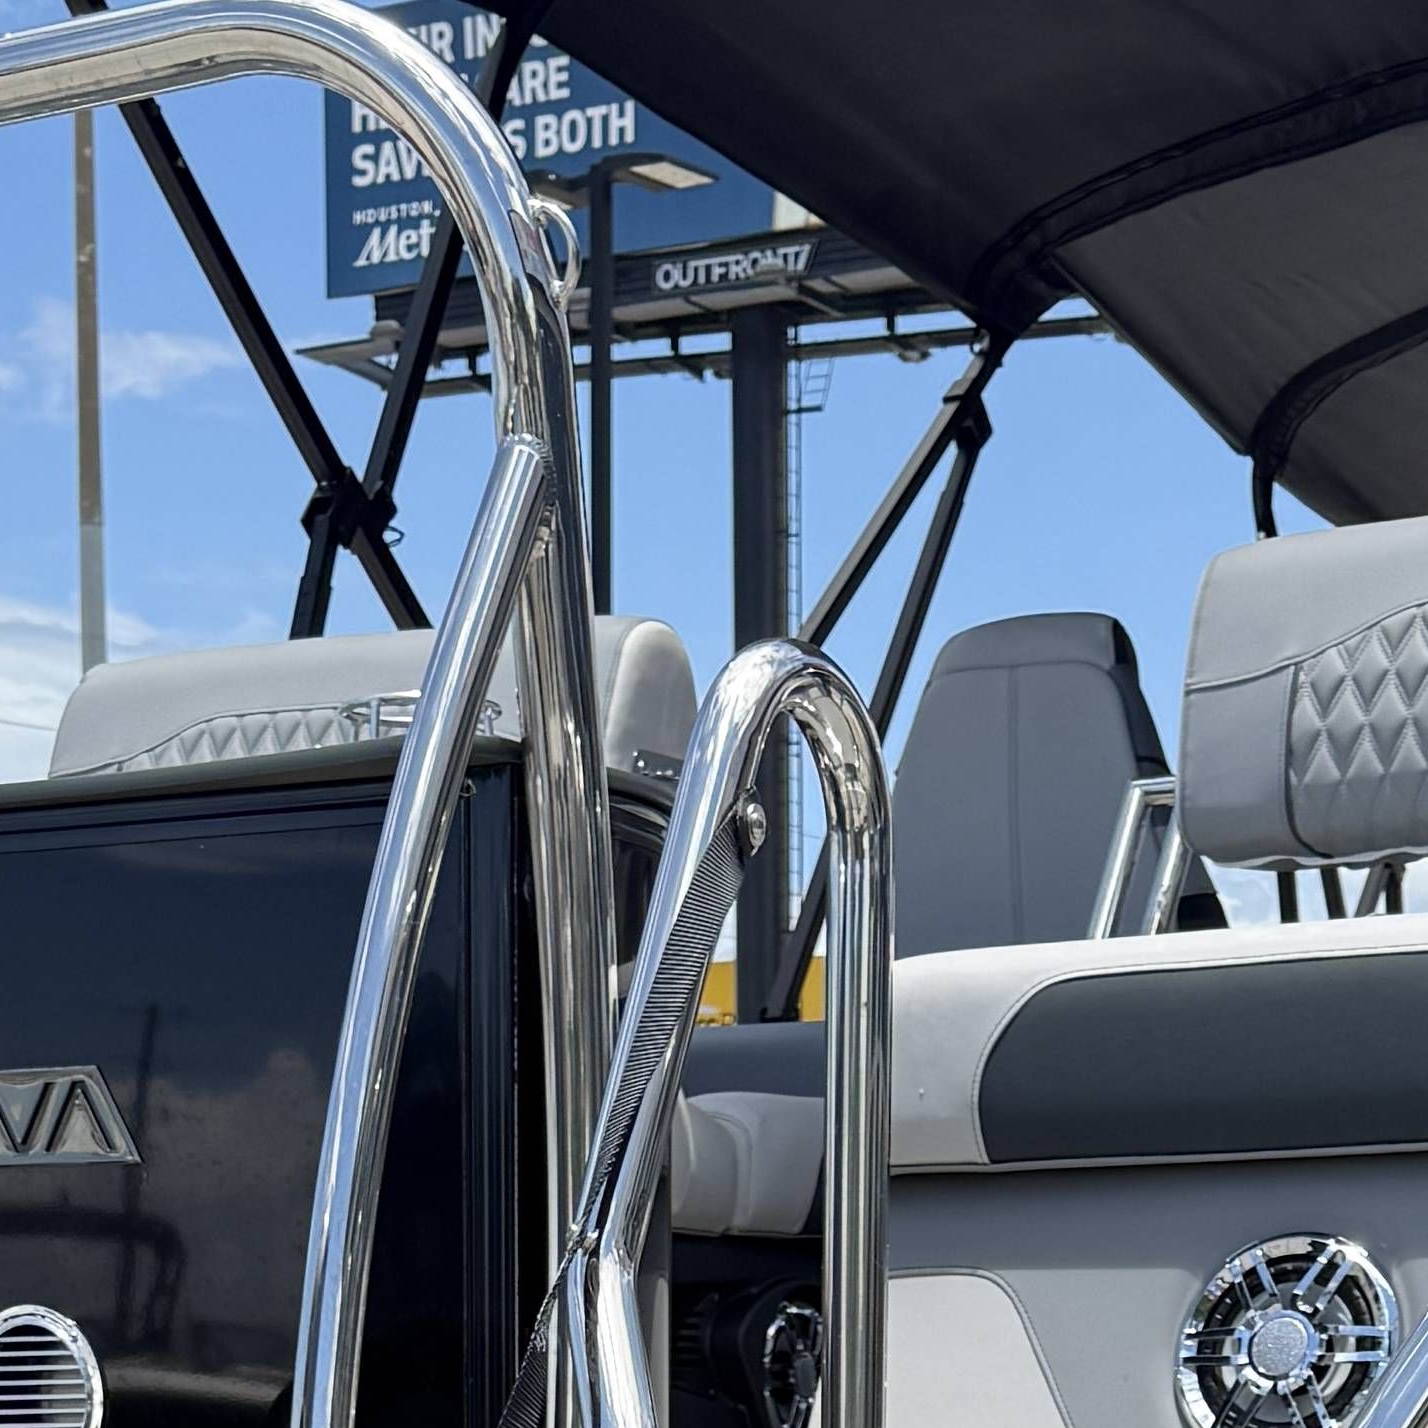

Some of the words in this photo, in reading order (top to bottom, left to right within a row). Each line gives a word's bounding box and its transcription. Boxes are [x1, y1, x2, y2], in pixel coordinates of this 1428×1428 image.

[534, 100, 635, 158] BOTH
[351, 140, 434, 188] SAV
[352, 219, 437, 267] Met
